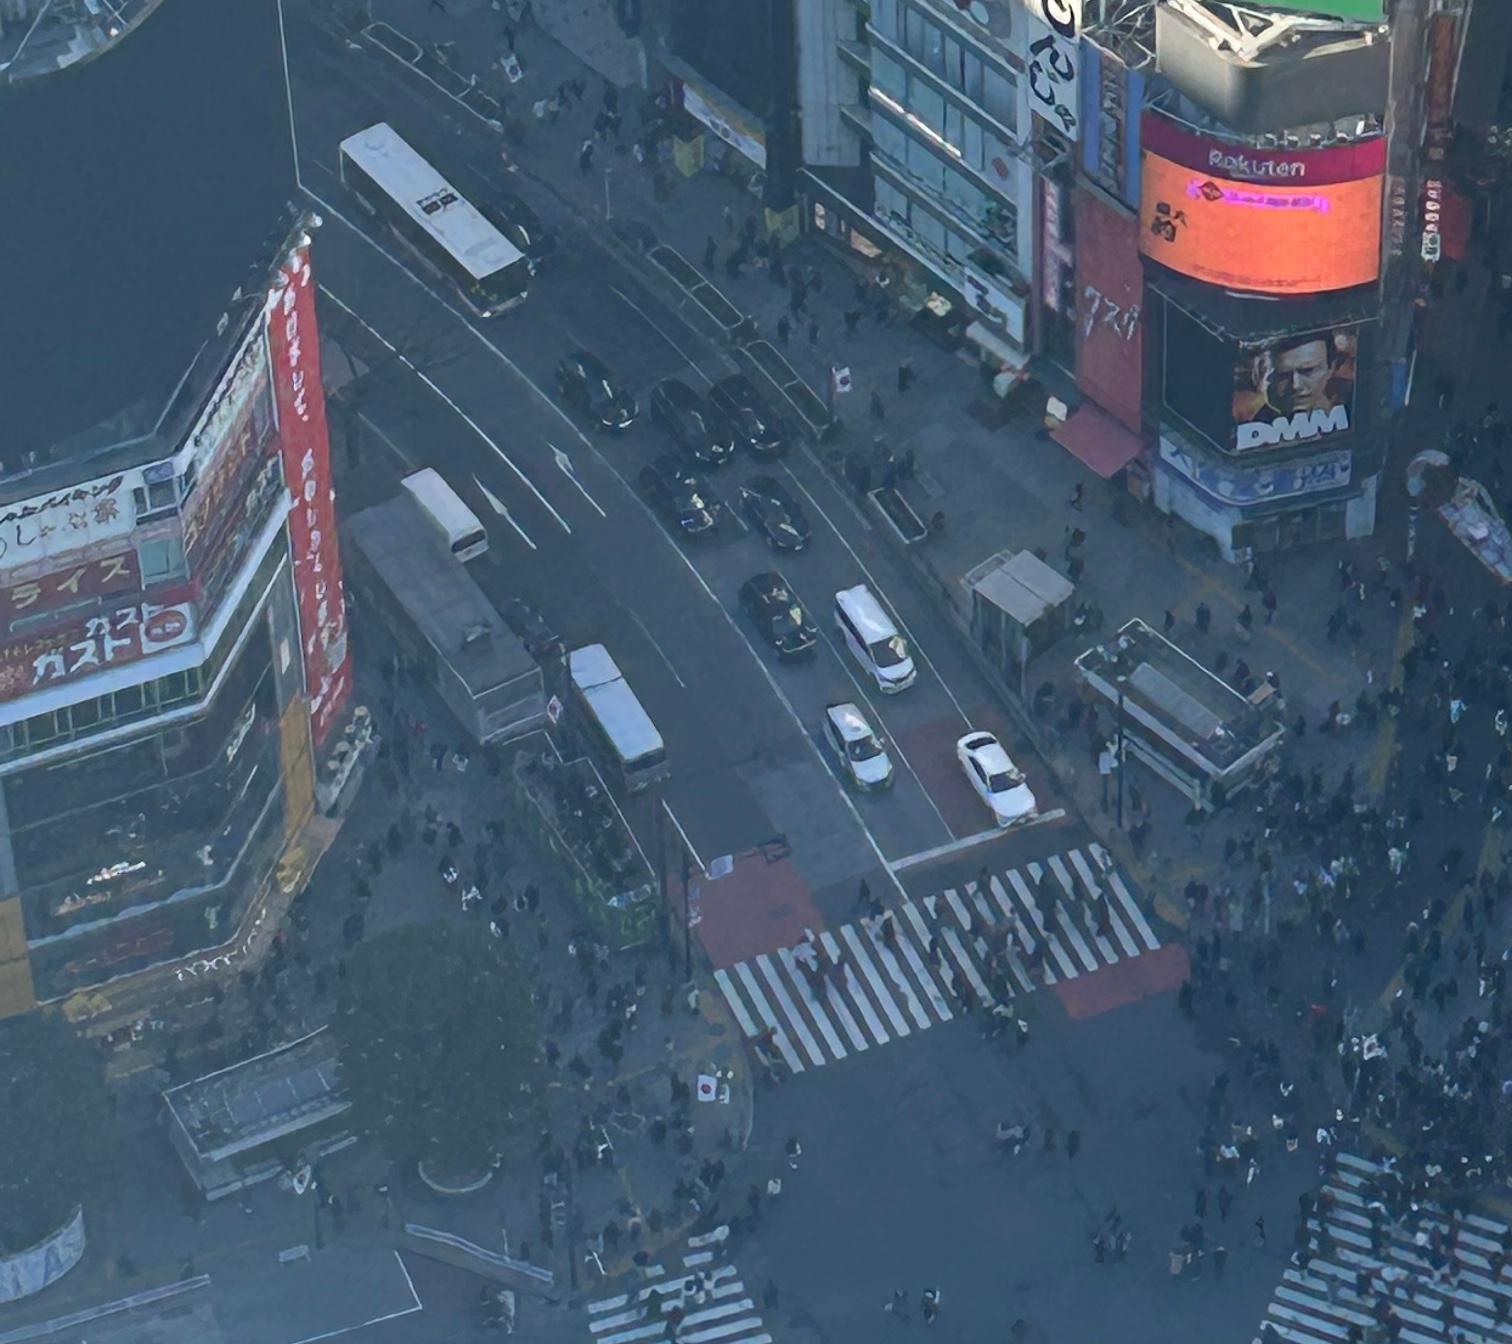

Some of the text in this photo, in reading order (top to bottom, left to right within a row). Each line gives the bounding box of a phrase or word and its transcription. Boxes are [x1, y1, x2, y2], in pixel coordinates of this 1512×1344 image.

[1208, 148, 1306, 177] Rakuten
[1235, 404, 1349, 451] DMM
[32, 636, 132, 686] ガスト
